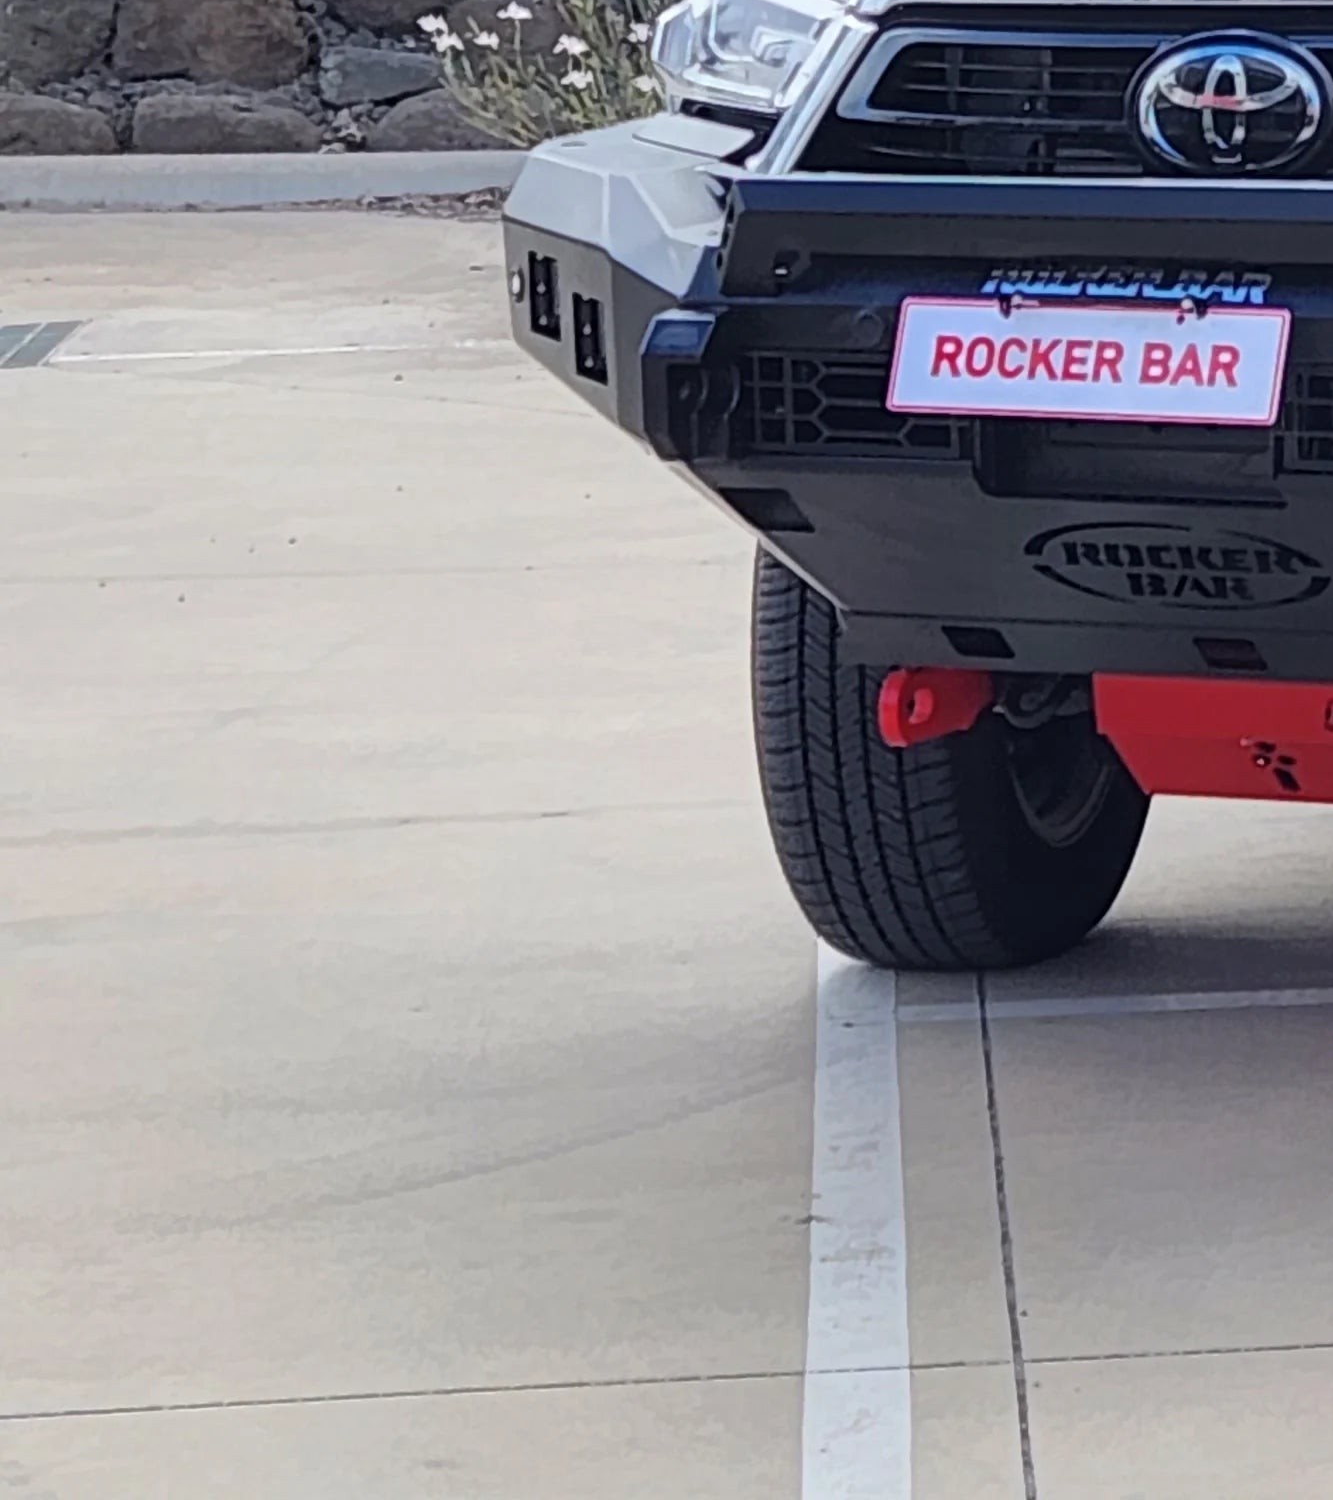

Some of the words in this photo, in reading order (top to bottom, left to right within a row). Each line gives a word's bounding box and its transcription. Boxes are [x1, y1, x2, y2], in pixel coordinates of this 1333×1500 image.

[930, 335, 1126, 384] ROCKER
[1137, 341, 1240, 388] BAR
[1061, 541, 1300, 576] ROCKER
[1126, 573, 1254, 601] BAR
